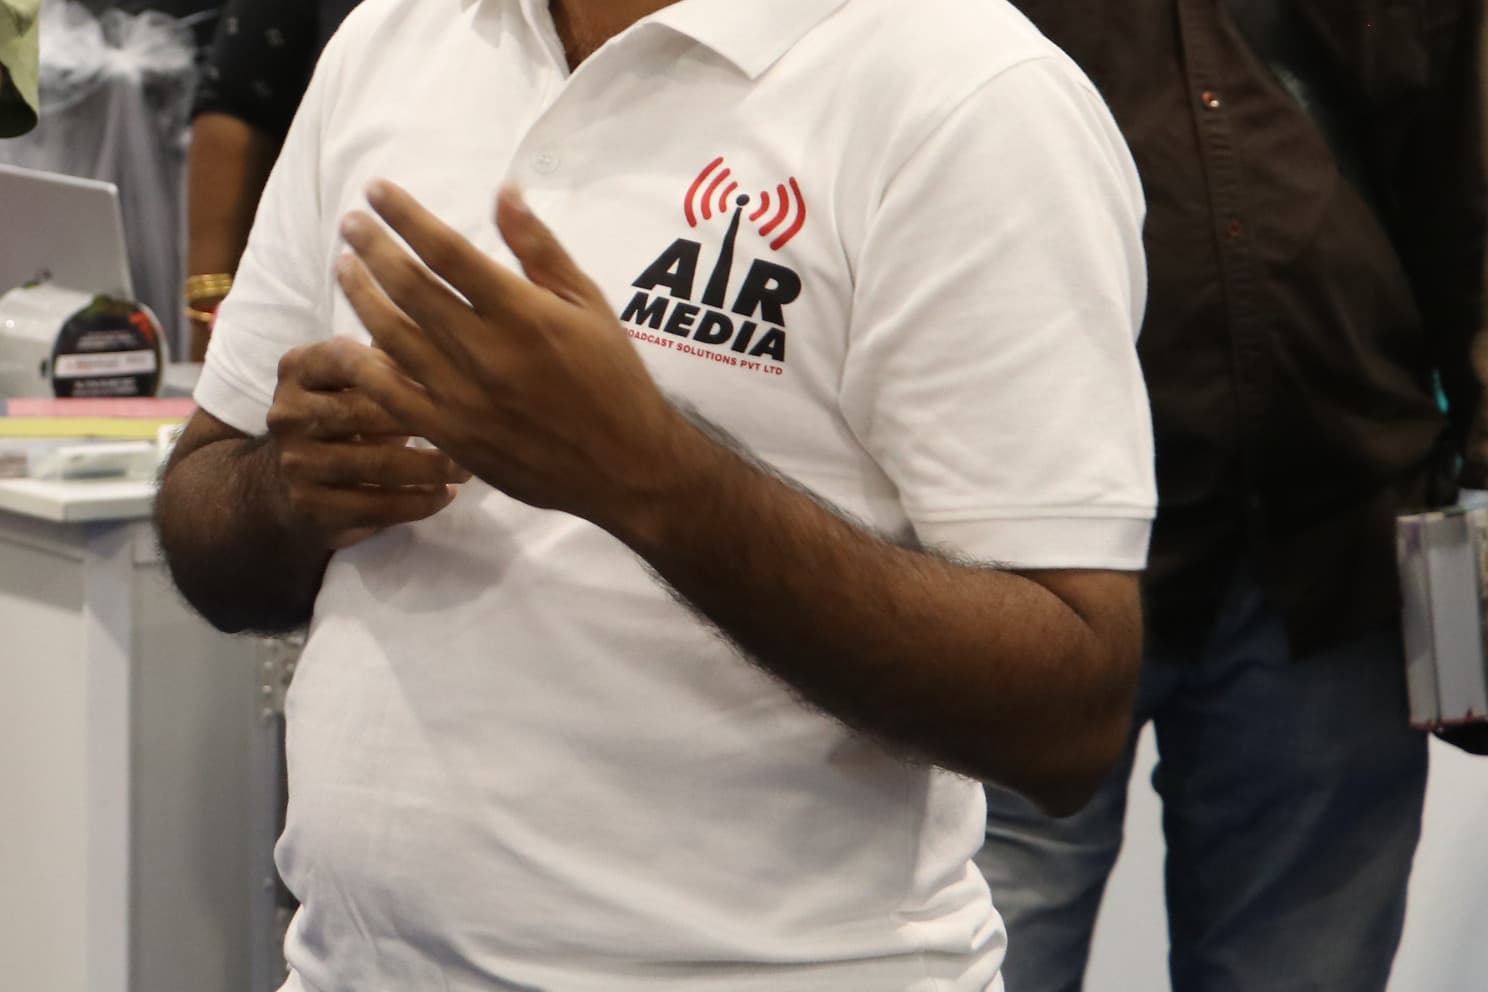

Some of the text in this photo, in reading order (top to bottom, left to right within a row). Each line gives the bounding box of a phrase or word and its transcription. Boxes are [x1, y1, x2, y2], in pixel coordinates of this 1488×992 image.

[630, 207, 802, 328] AIR
[619, 291, 787, 363] MEDIA
[677, 341, 737, 368] SOLUTIONS
[740, 359, 761, 372] PVT
[763, 364, 783, 376] LTD
